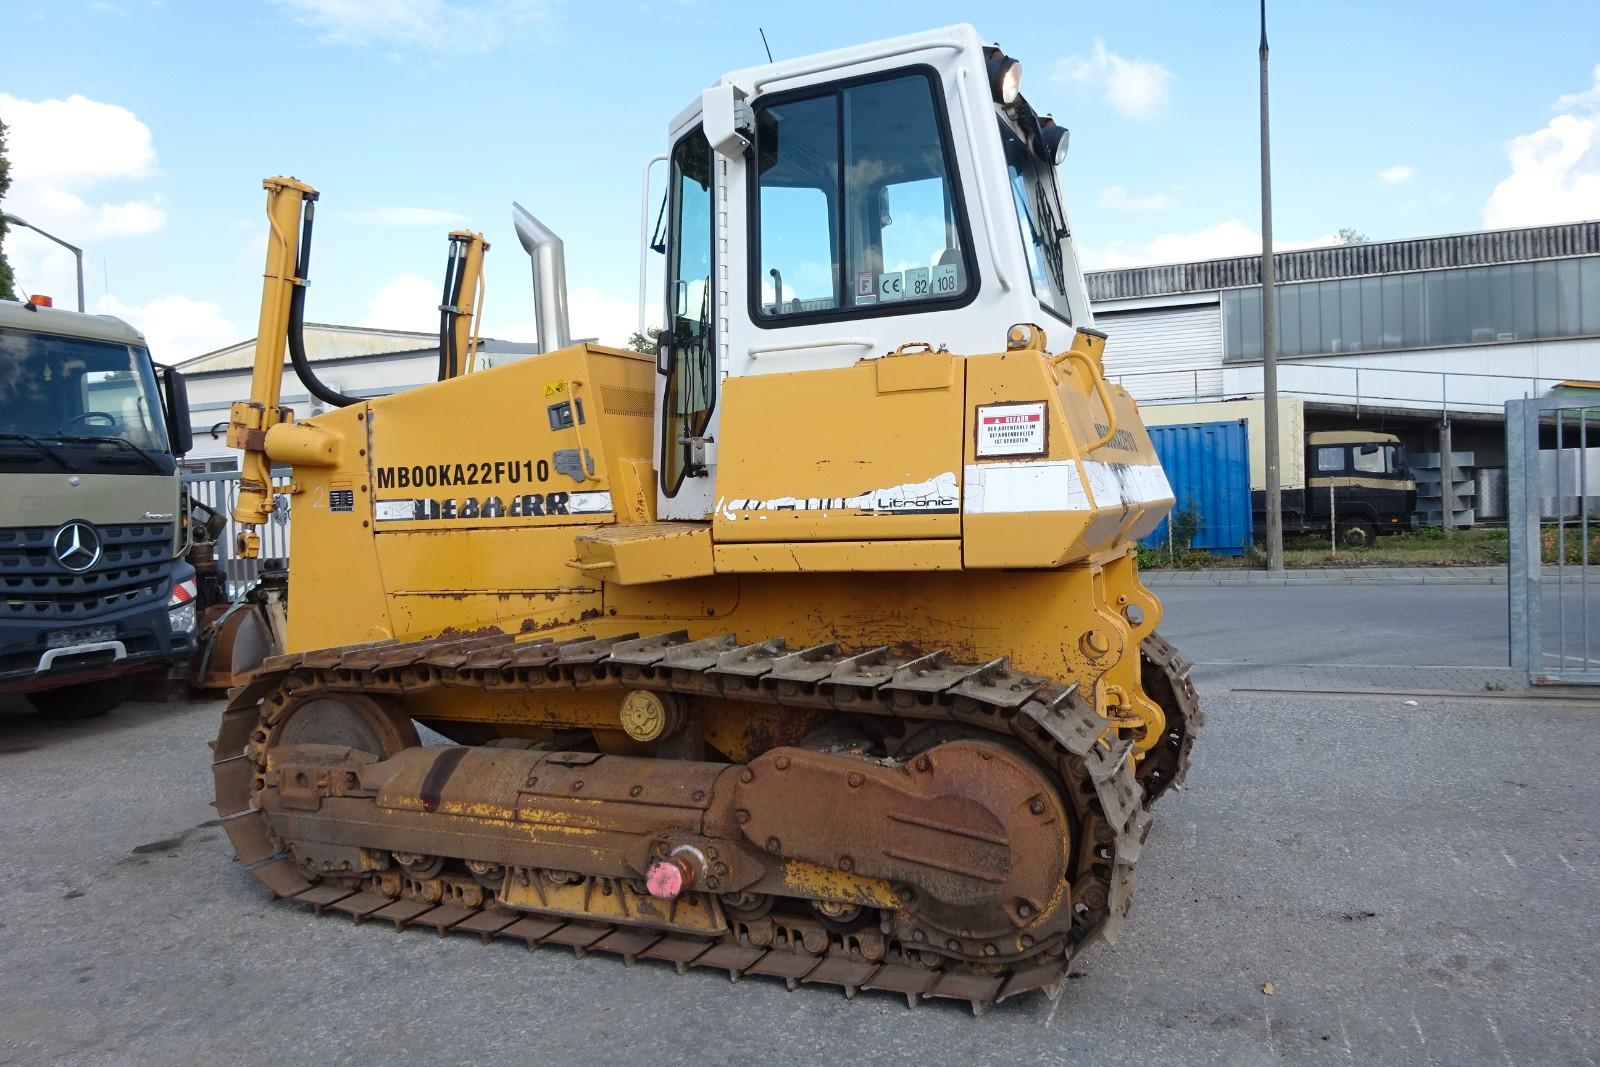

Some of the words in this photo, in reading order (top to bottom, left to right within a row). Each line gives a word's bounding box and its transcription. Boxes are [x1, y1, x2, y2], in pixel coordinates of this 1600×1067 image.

[882, 278, 900, 293] CE
[914, 279, 927, 294] 82
[938, 275, 955, 291] 108
[878, 497, 953, 508] Litronic
